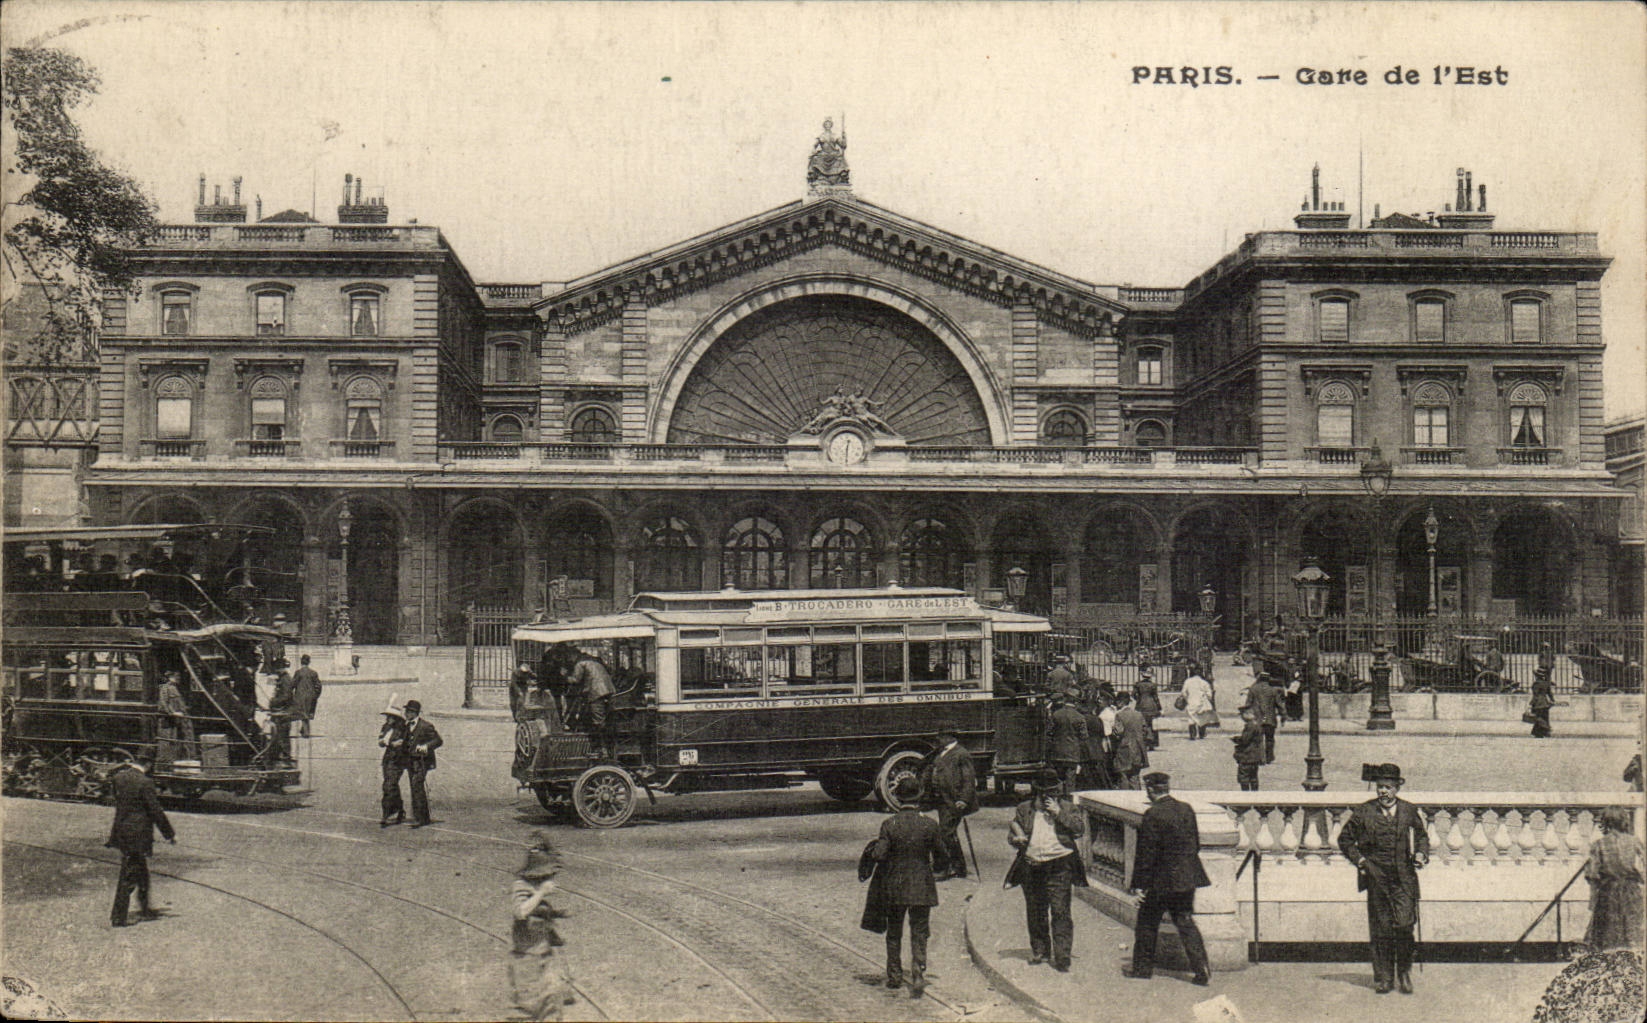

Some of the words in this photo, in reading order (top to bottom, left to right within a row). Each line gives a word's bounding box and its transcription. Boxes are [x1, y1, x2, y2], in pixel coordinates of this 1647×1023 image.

[775, 602, 782, 611] B
[789, 599, 873, 611] TROCADERO
[887, 599, 923, 609] GARE
[695, 701, 780, 710] COMPAGNIE
[793, 698, 866, 707] GENERALE
[878, 695, 904, 704] DES
[916, 693, 973, 703] OMNIBUS
